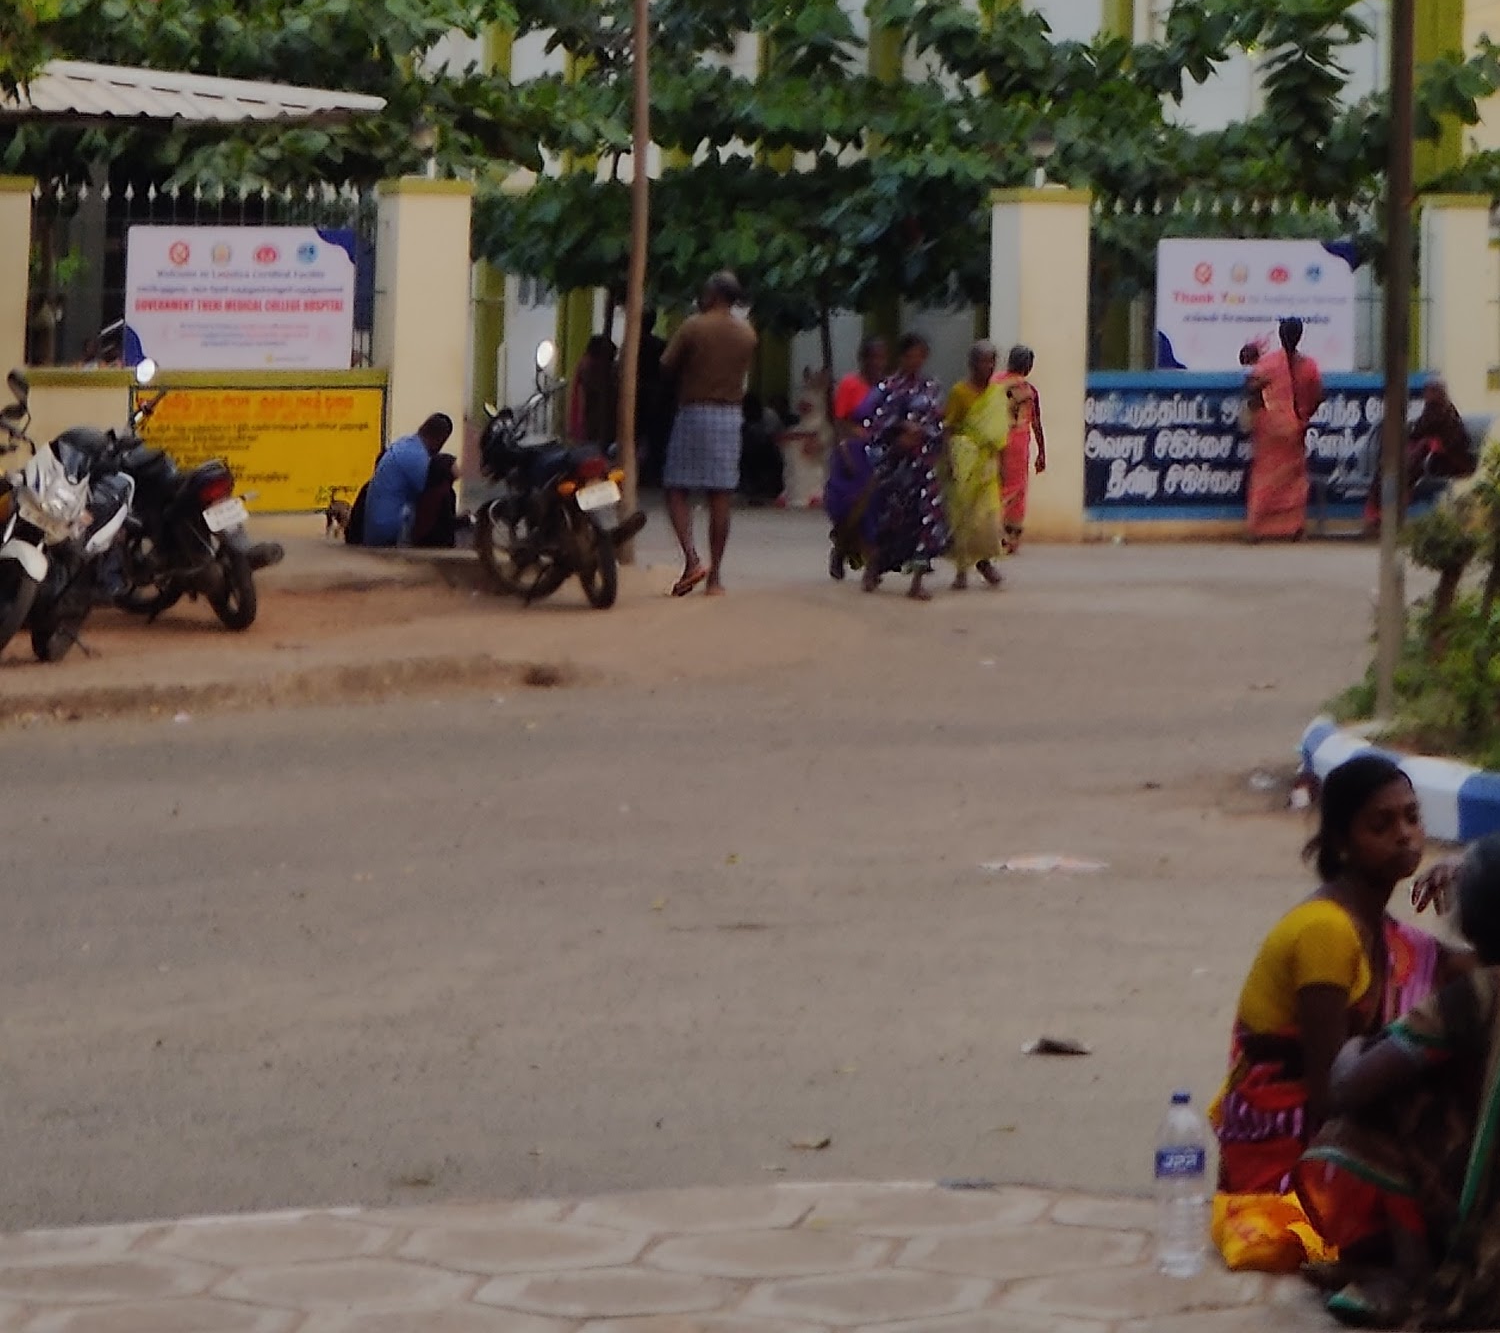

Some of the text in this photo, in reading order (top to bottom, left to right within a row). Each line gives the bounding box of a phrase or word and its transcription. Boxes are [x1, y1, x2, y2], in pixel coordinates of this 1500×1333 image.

[1173, 292, 1215, 304] Thank
[1220, 292, 1246, 304] You
[135, 299, 193, 312] GOVERNMENT
[224, 299, 262, 312] MEDICAL
[265, 299, 301, 312] COLLEGE
[303, 299, 343, 312] HOSPITAL
